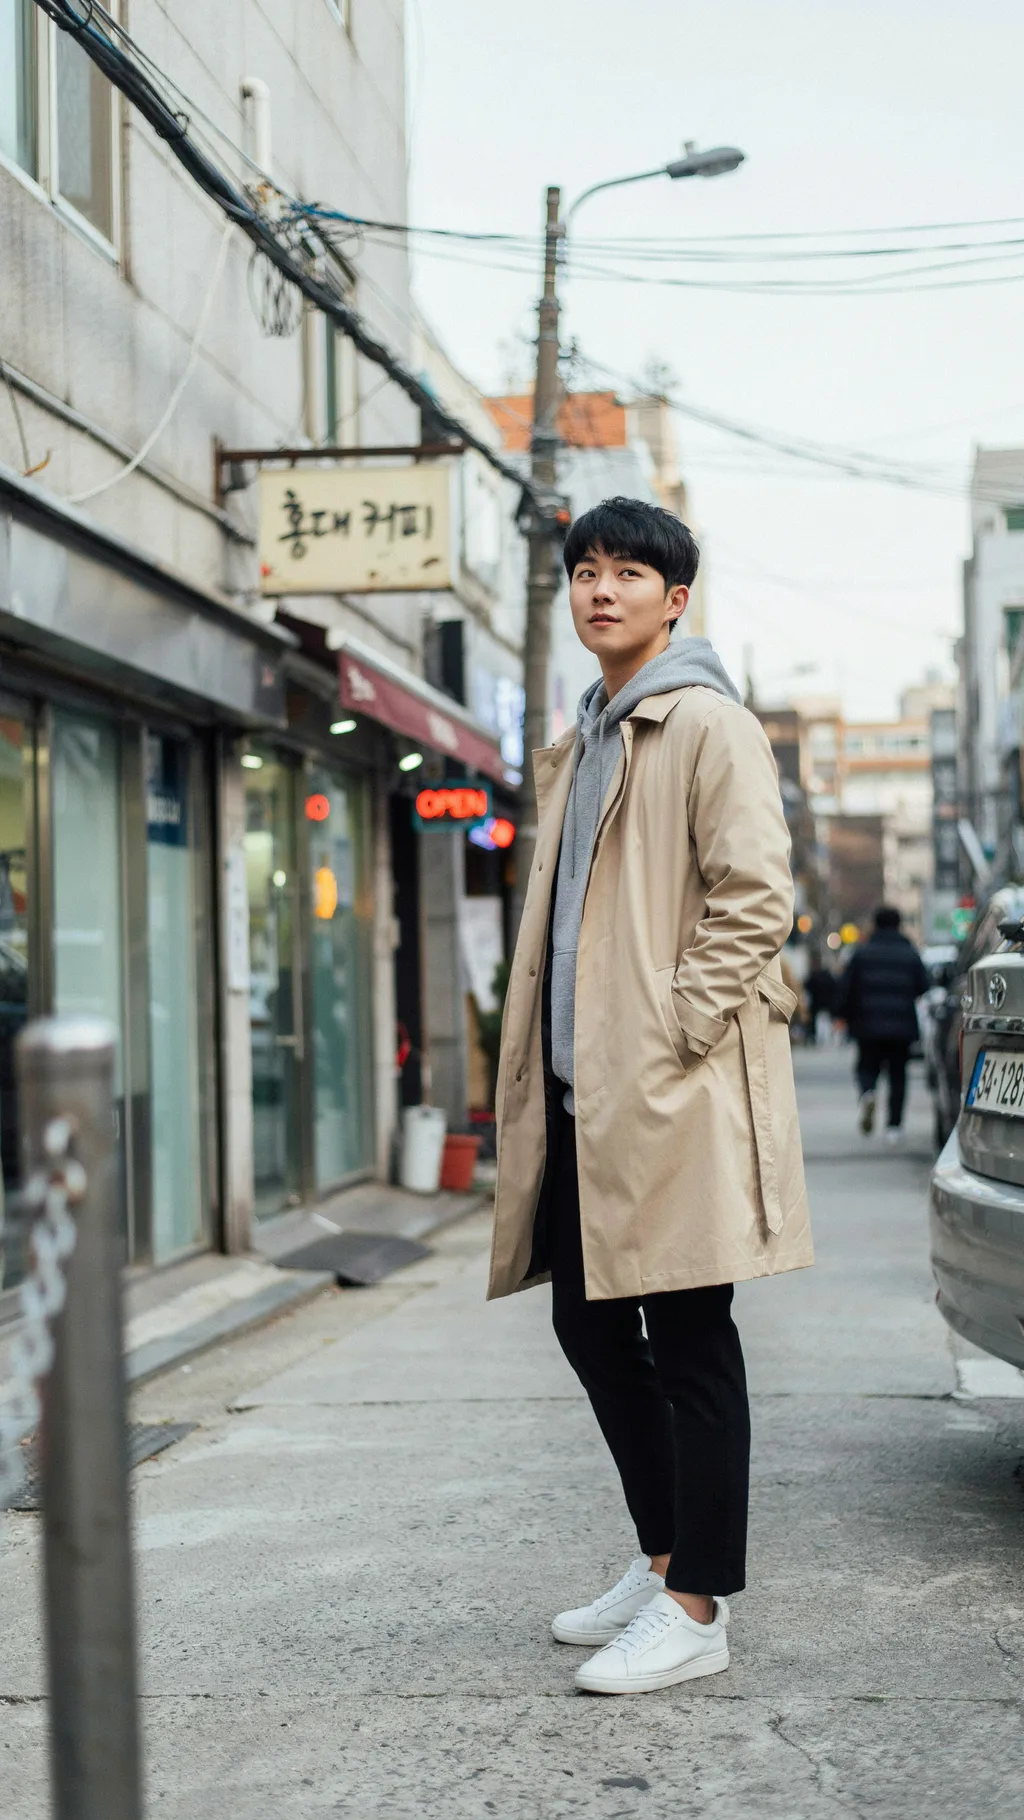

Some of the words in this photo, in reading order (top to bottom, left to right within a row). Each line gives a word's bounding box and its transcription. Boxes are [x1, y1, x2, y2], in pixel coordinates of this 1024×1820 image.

[278, 488, 352, 560] 홍대
[361, 499, 434, 543] 커피
[415, 788, 488, 819] OPEN
